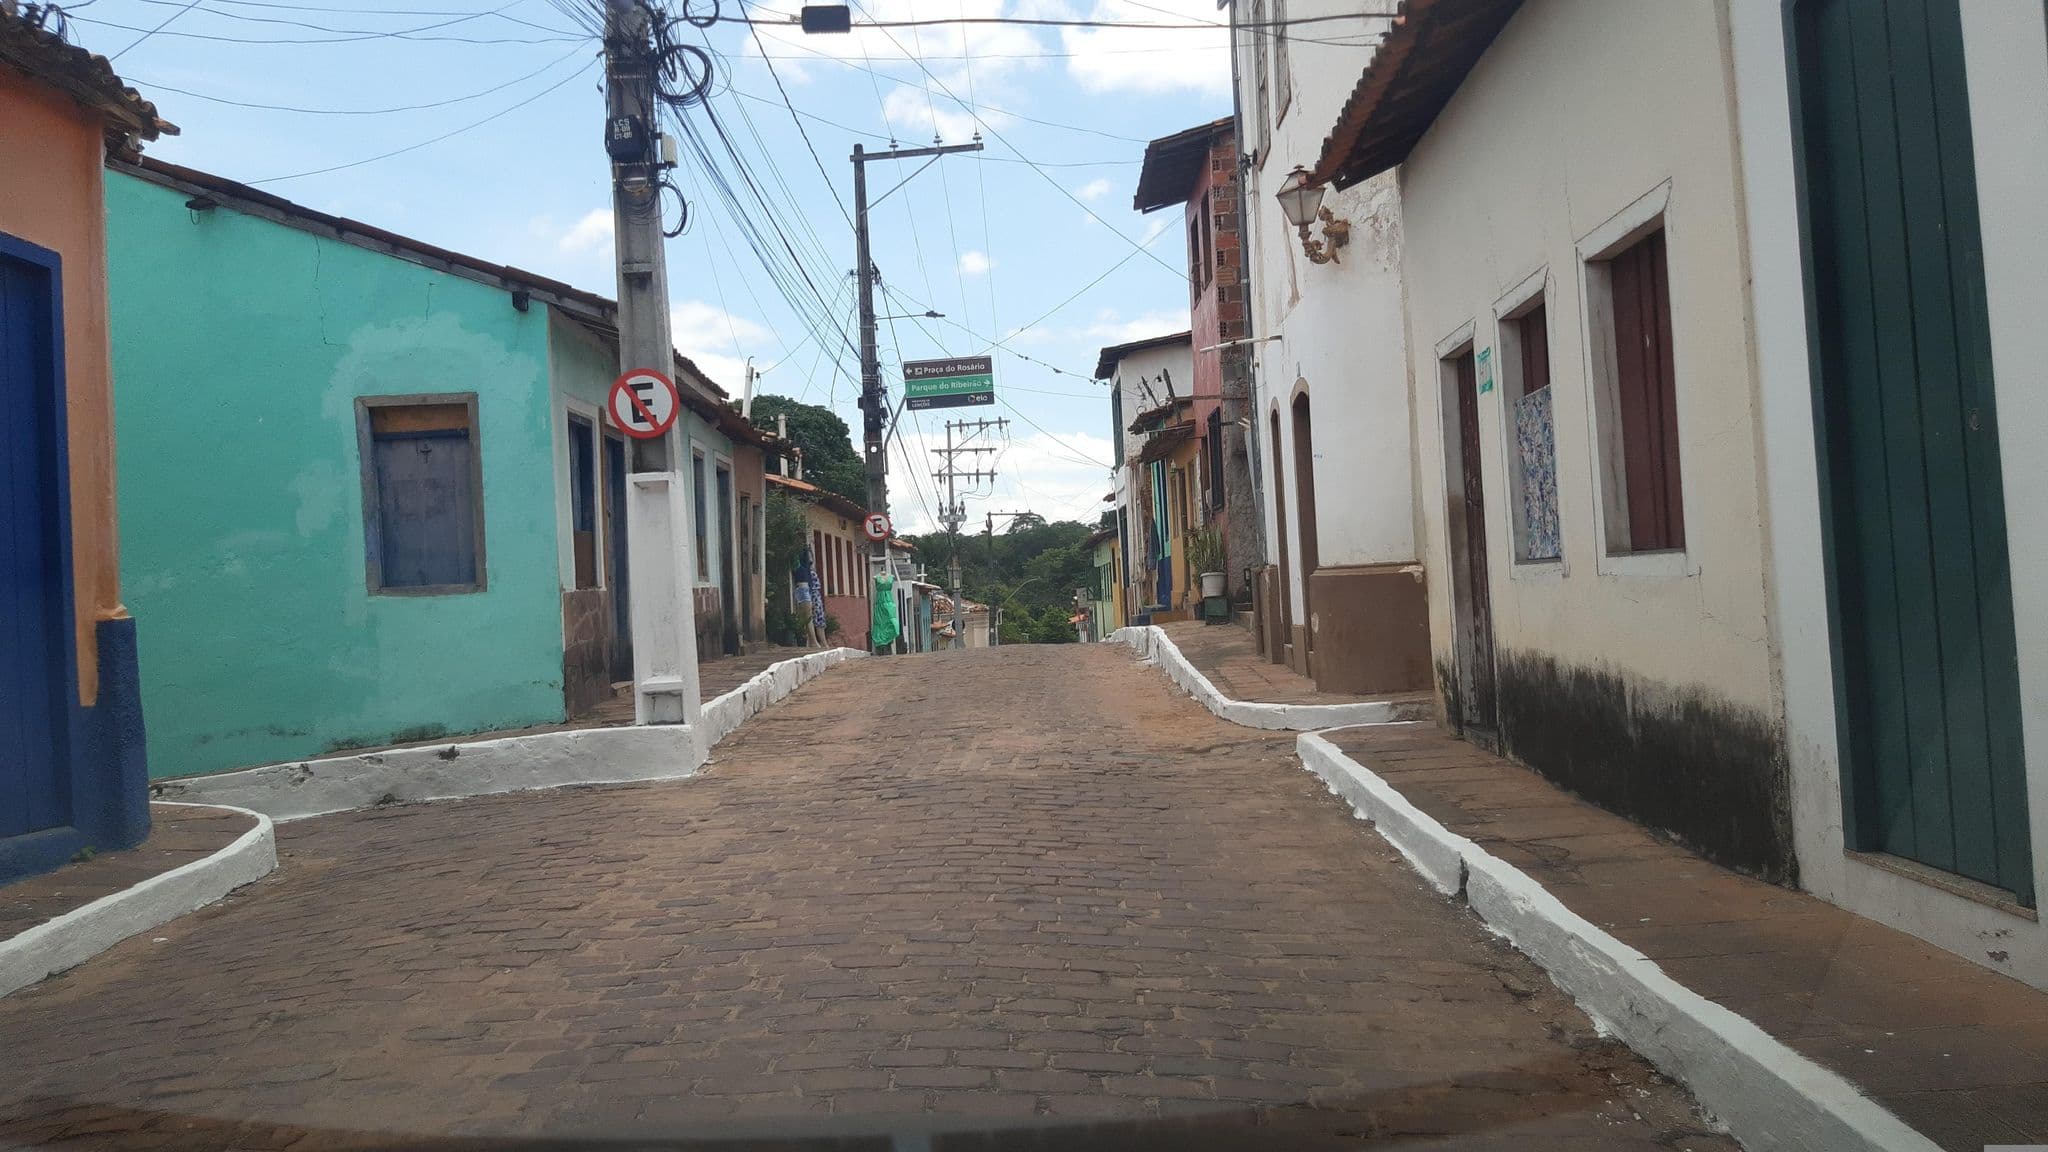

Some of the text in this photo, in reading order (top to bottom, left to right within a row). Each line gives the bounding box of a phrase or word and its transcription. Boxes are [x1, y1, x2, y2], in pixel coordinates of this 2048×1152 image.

[923, 362, 985, 375] Praça do Rosário
[911, 380, 982, 392] Parque do Ribeirão
[630, 382, 657, 423] E
